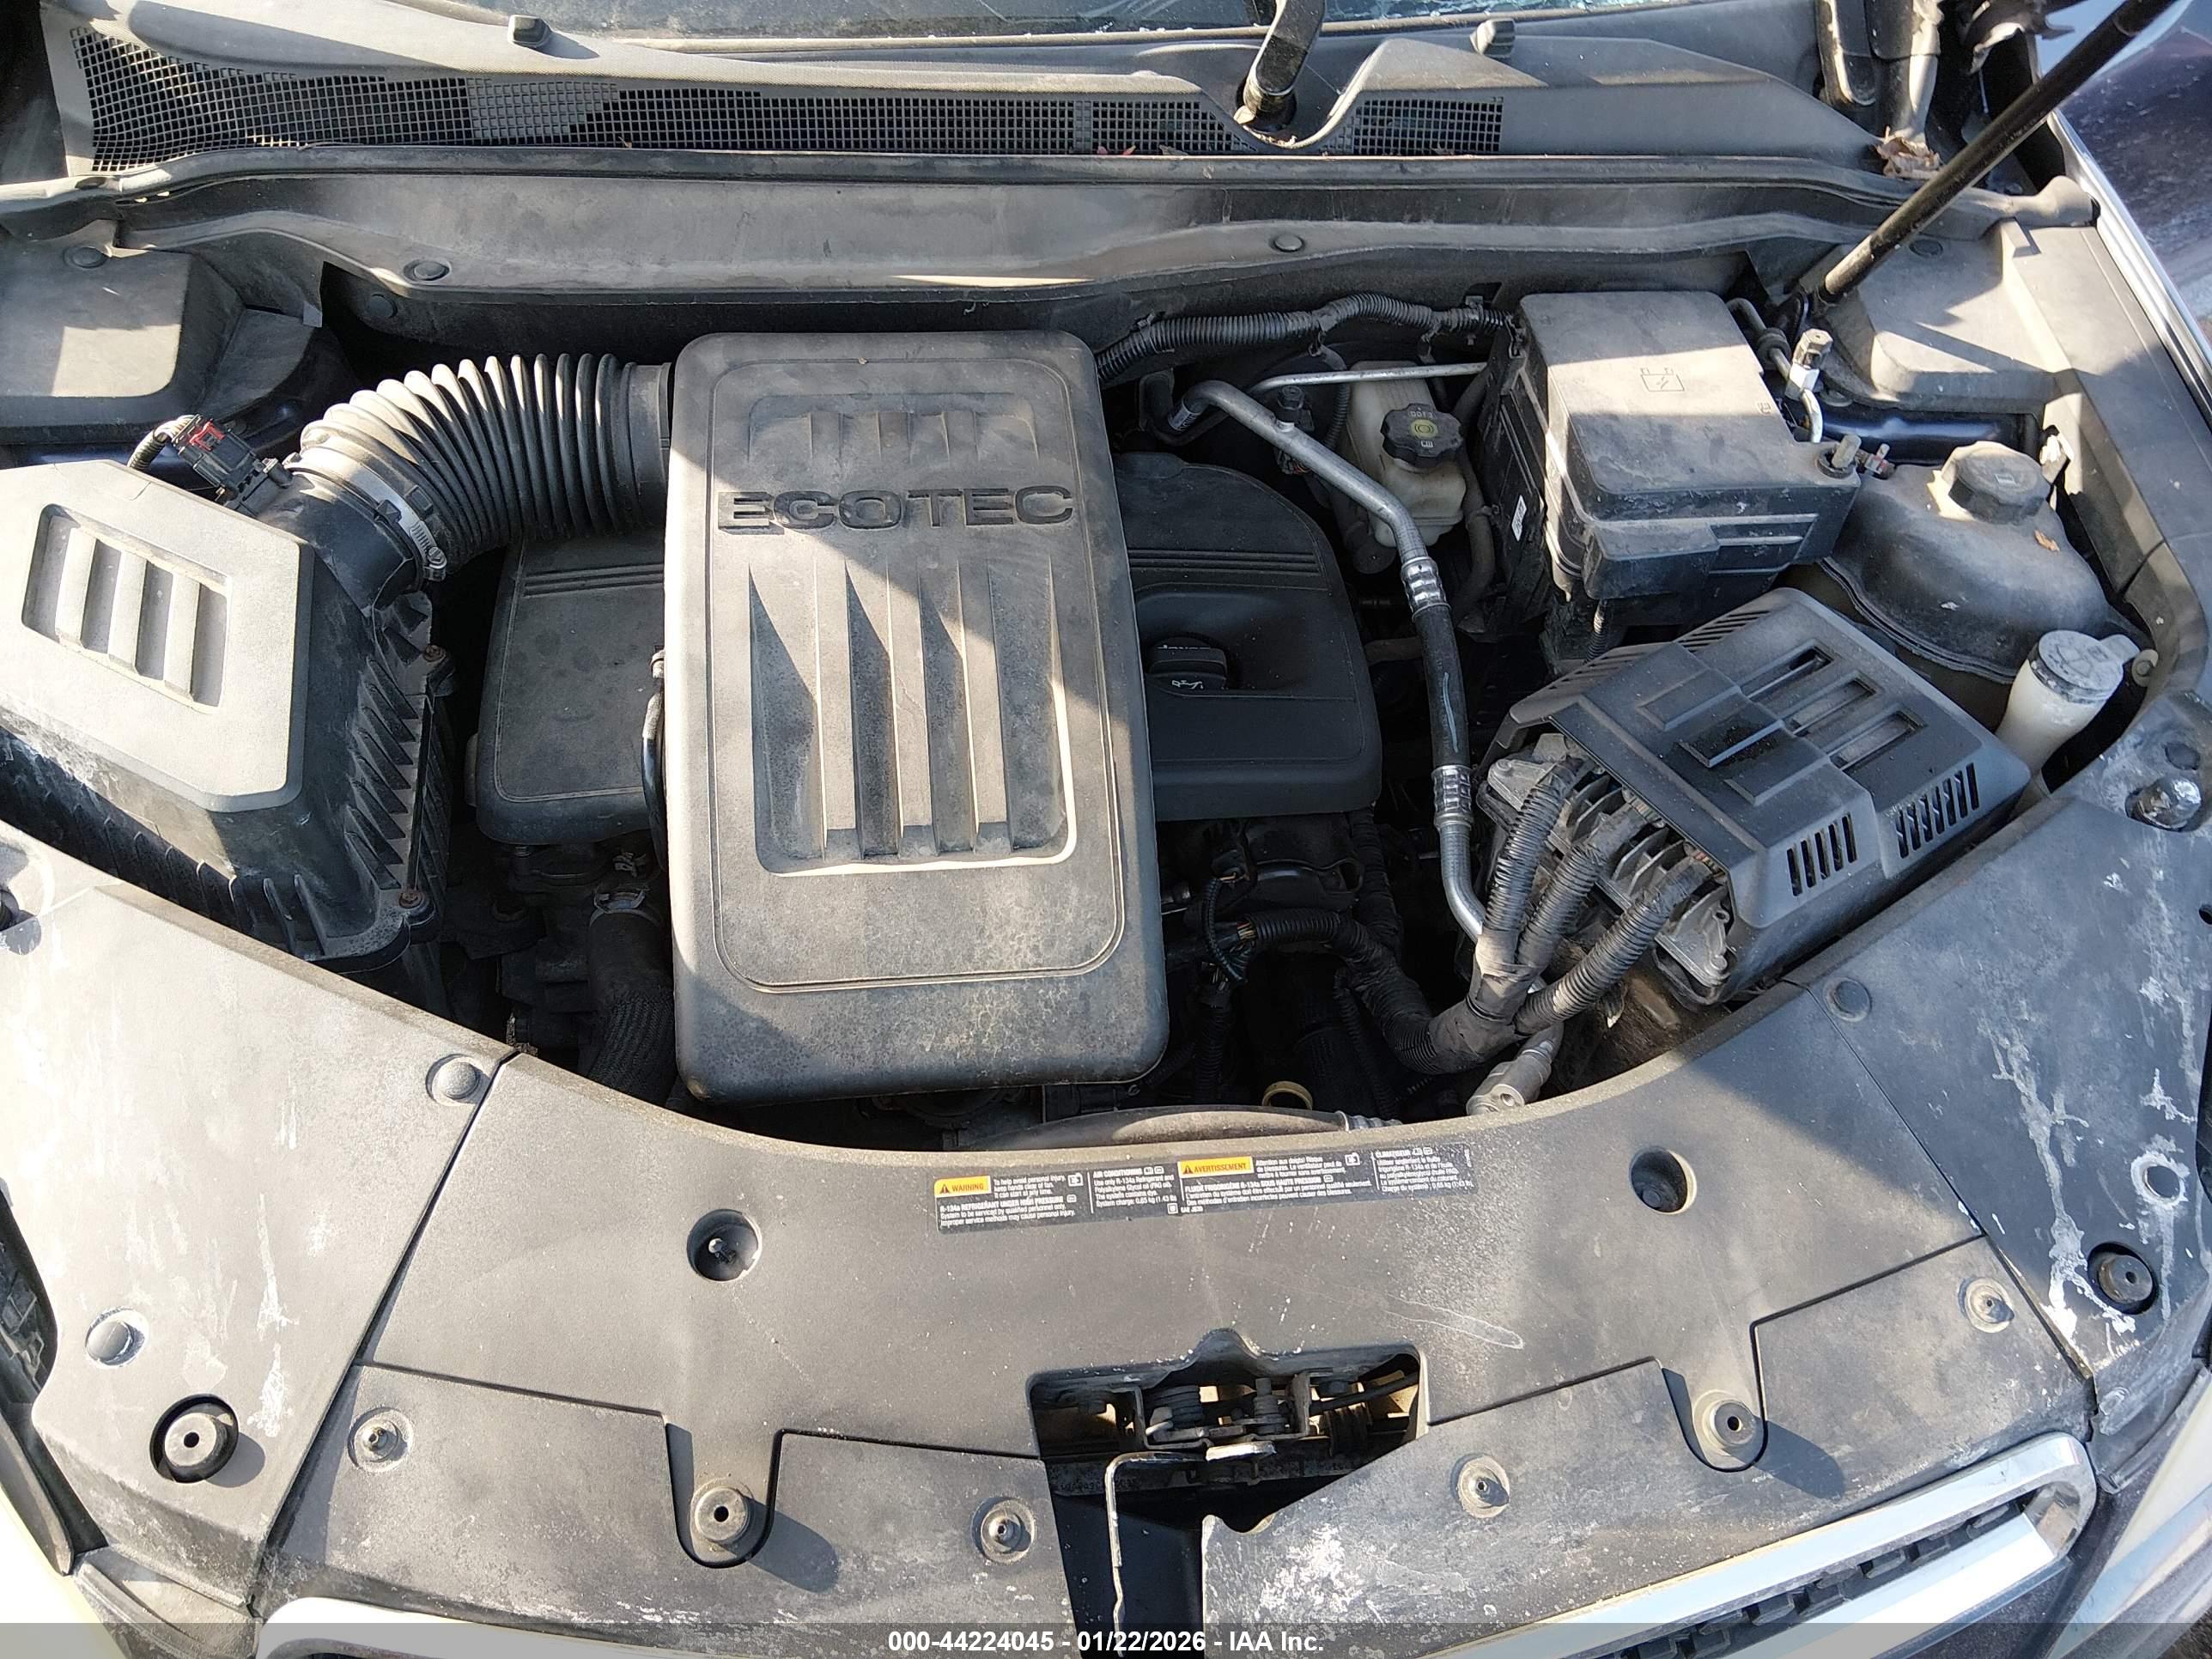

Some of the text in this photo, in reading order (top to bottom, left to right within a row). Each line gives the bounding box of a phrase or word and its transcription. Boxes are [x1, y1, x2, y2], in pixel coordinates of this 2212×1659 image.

[718, 485, 1073, 533] ECOTEC
[1194, 1162, 1245, 1173] AVERTISSEMENT
[951, 1182, 983, 1191] WARNING
